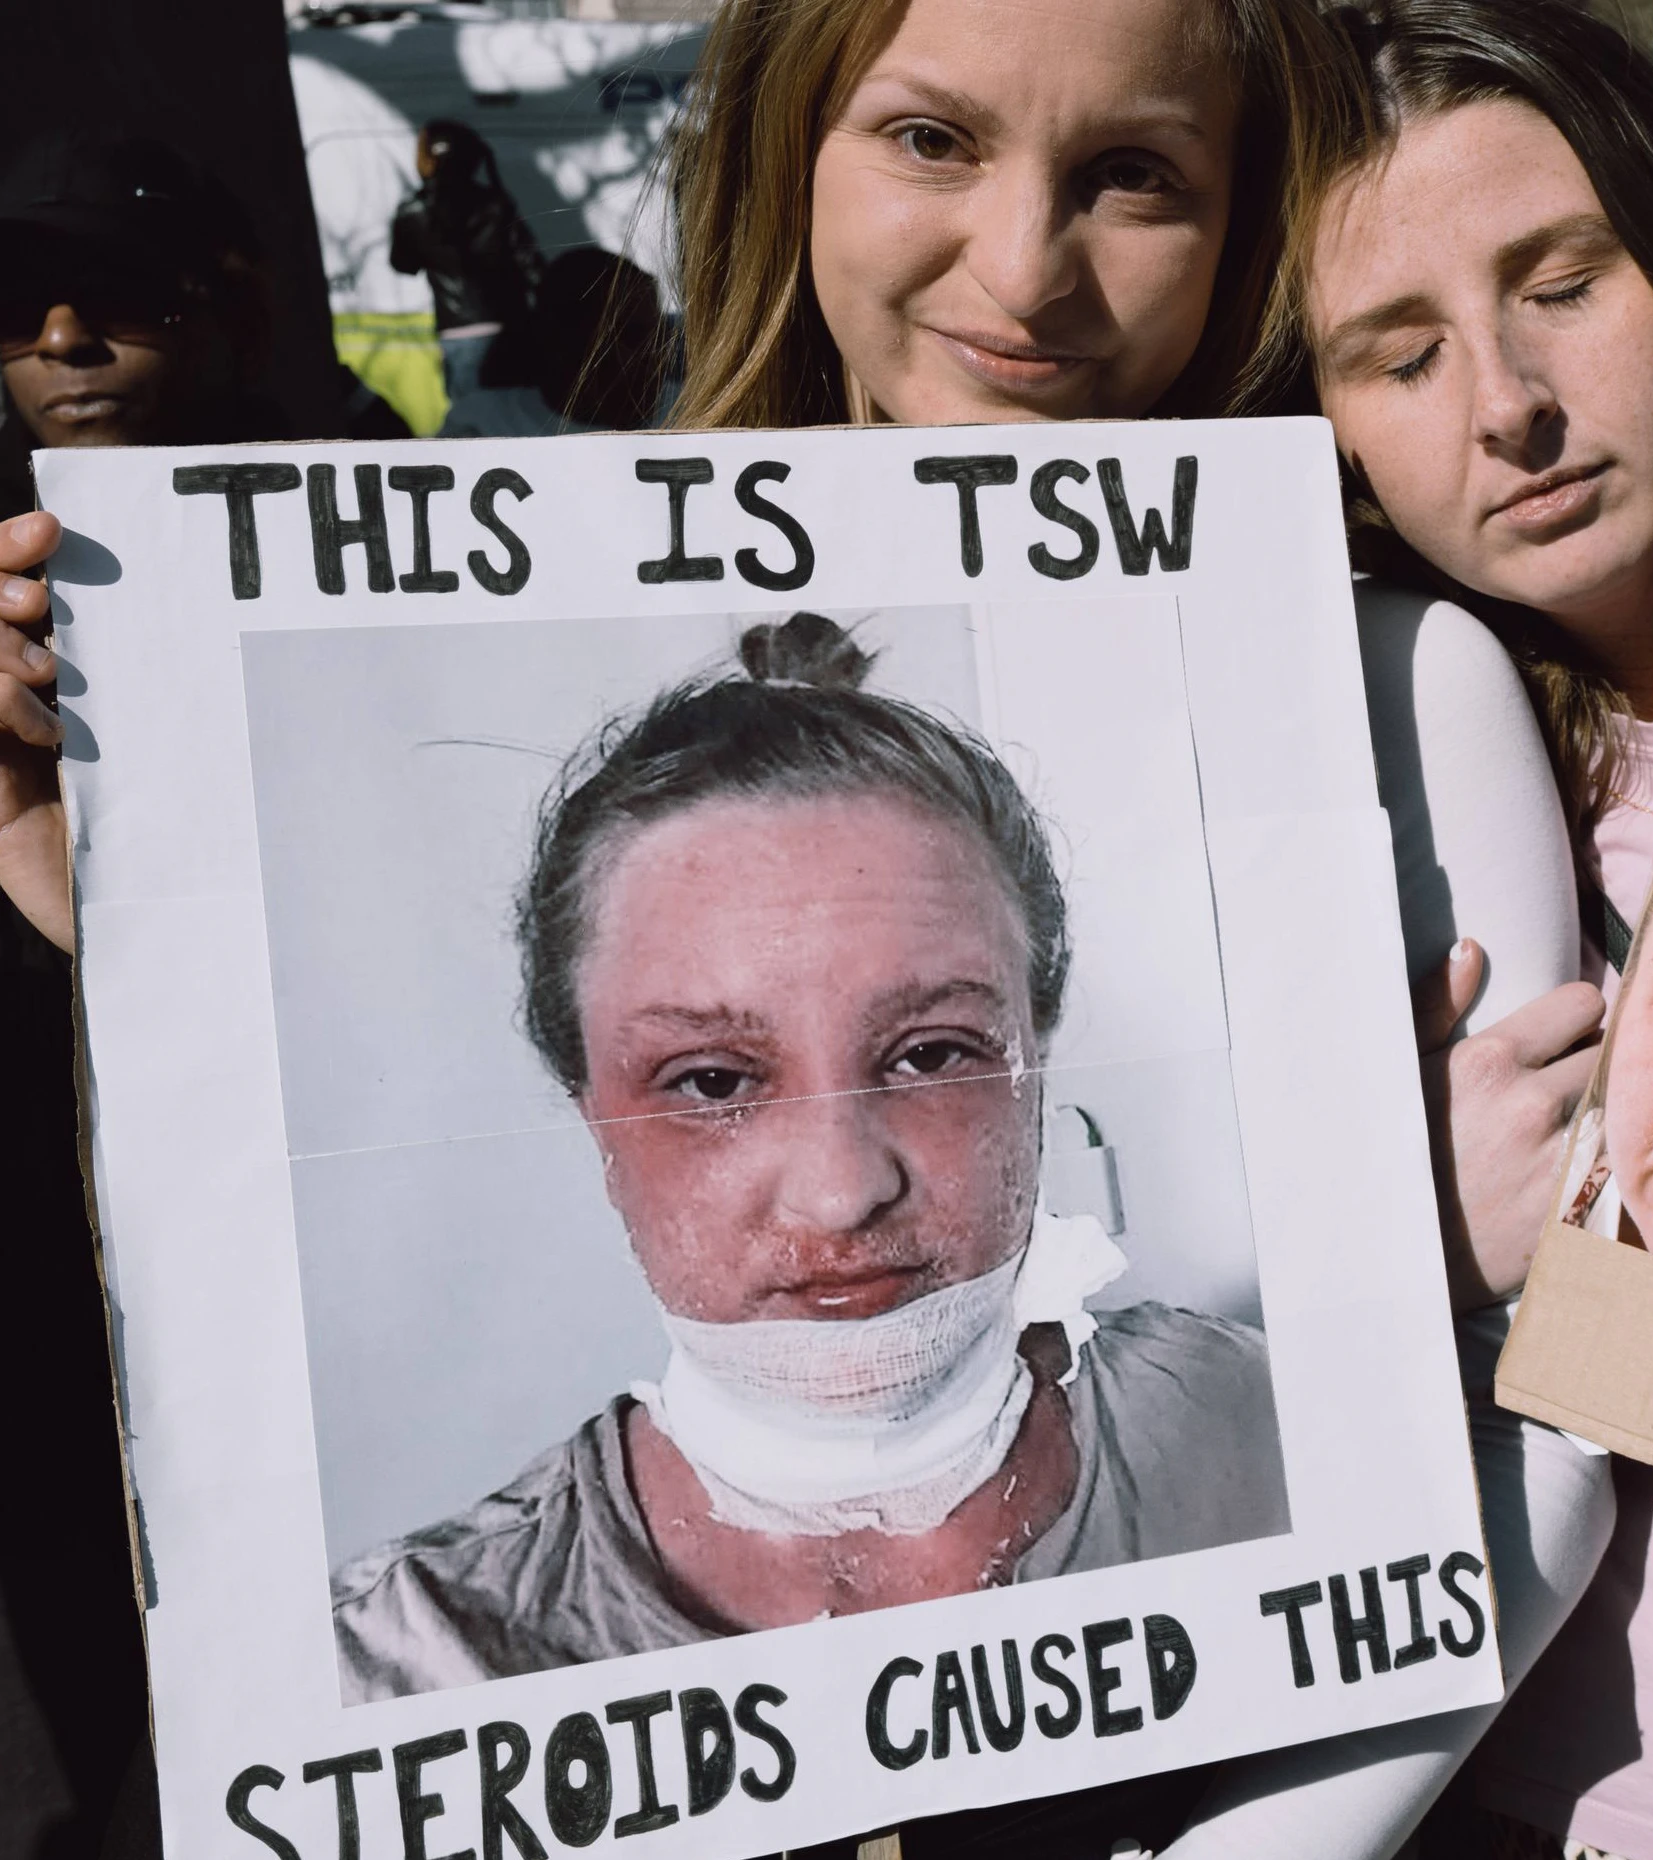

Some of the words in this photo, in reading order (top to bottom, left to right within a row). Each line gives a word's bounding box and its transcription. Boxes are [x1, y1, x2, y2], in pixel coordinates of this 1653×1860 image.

[172, 462, 534, 600] THIS
[634, 457, 815, 592] IS
[914, 455, 1200, 578] TSW
[225, 1683, 796, 1860] STEROIDS
[866, 1613, 1198, 1772] CAUSED
[1259, 1551, 1486, 1690] THIS
